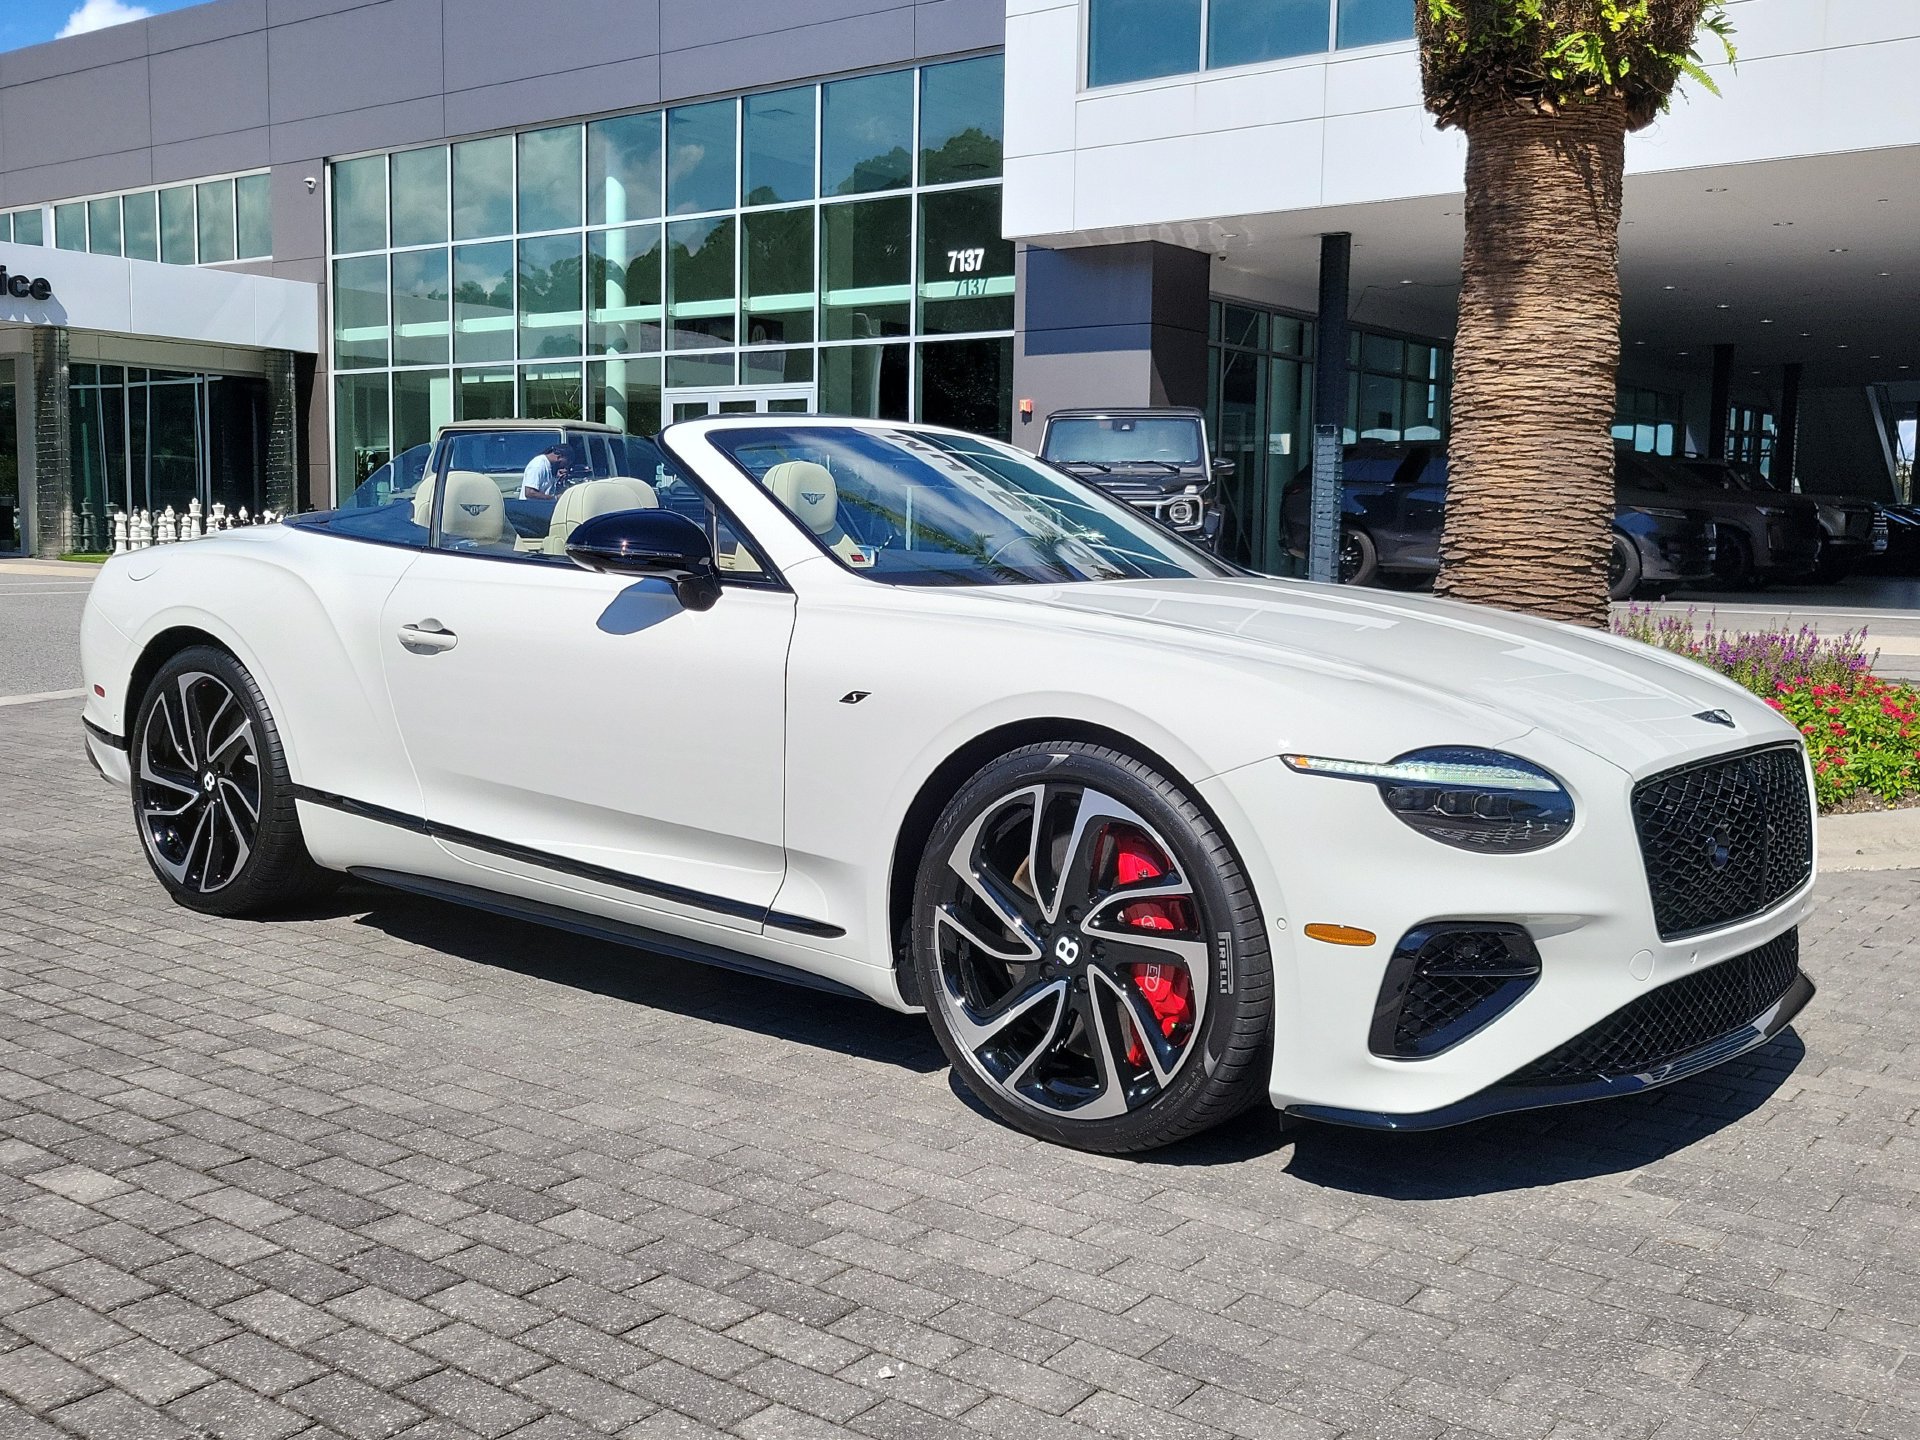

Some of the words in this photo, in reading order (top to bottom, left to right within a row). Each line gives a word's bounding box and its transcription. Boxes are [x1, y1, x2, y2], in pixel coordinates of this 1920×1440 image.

[947, 248, 985, 273] 7137
[1055, 936, 1079, 965] B
[1217, 931, 1234, 995] PIRELLI
